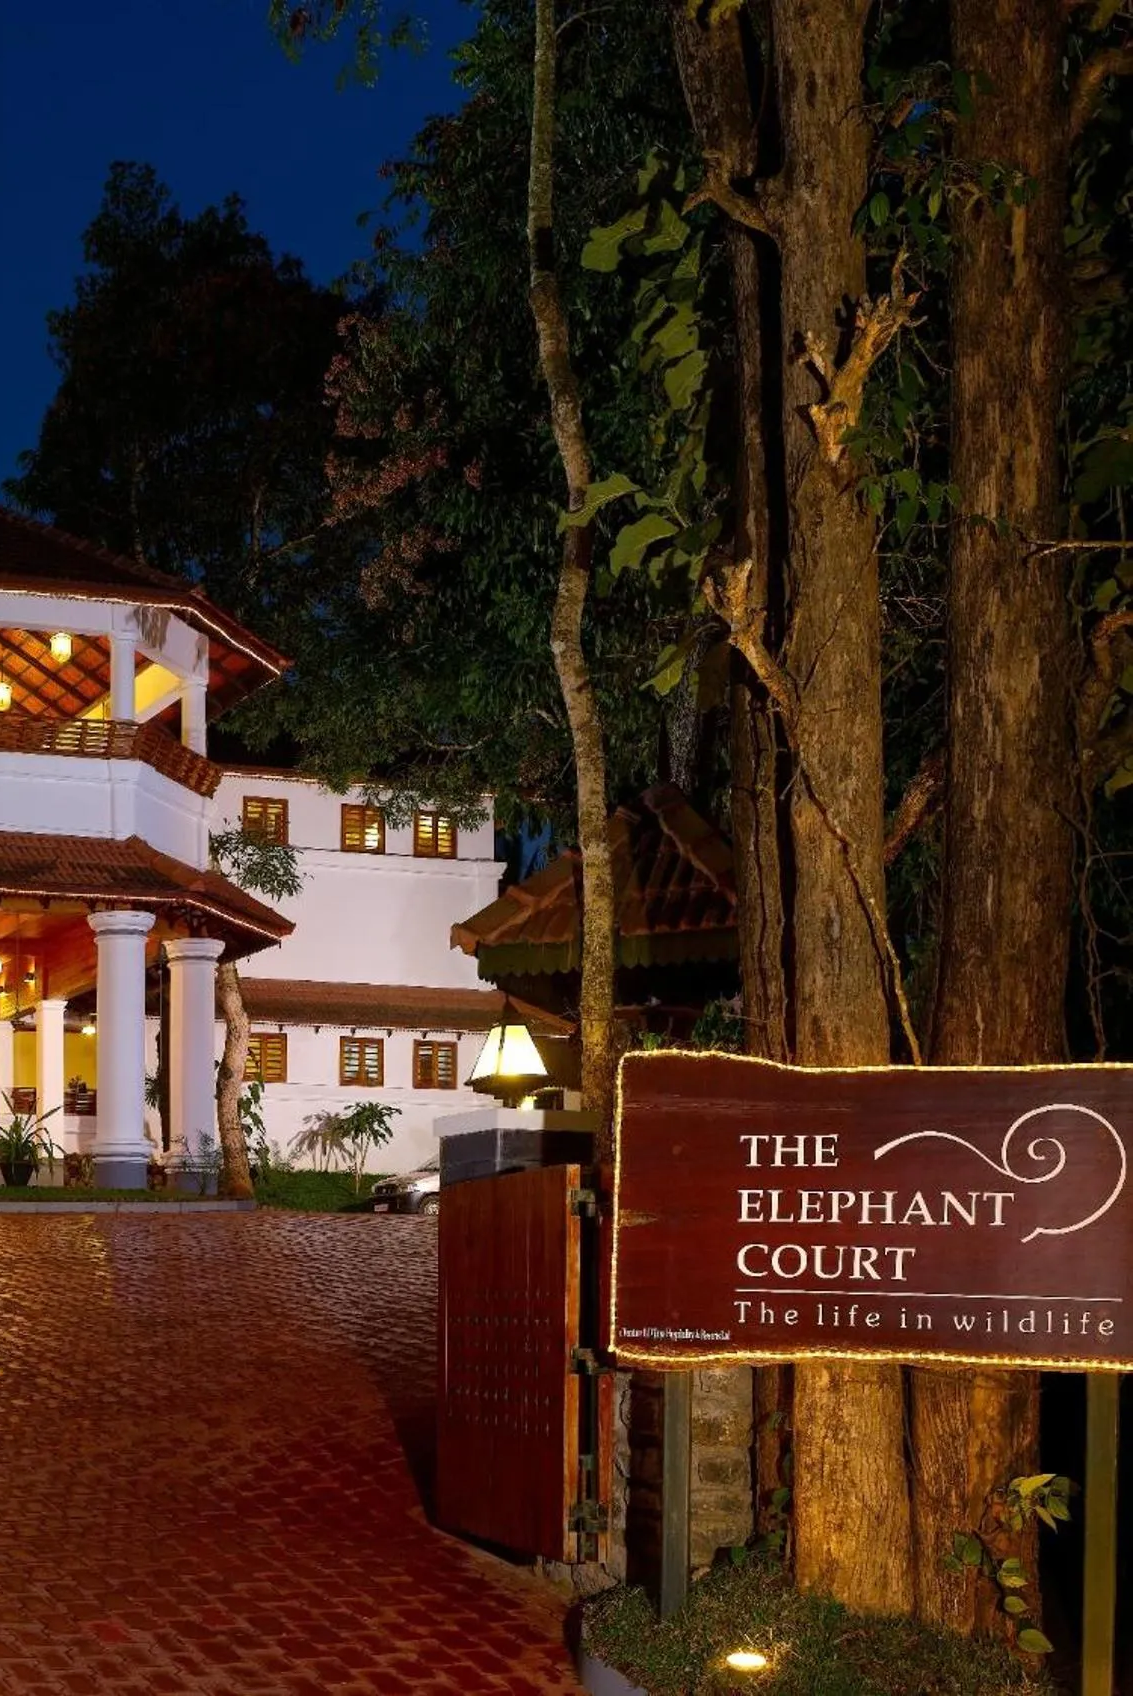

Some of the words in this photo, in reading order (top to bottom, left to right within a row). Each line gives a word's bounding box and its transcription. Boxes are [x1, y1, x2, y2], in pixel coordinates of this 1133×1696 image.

[739, 1133, 839, 1168] THE
[737, 1189, 1015, 1227] ELEPHANT
[736, 1243, 916, 1281] COURT
[733, 1301, 798, 1326] The
[817, 1303, 880, 1329] life
[900, 1307, 932, 1331] in
[953, 1309, 1115, 1337] wildlife
